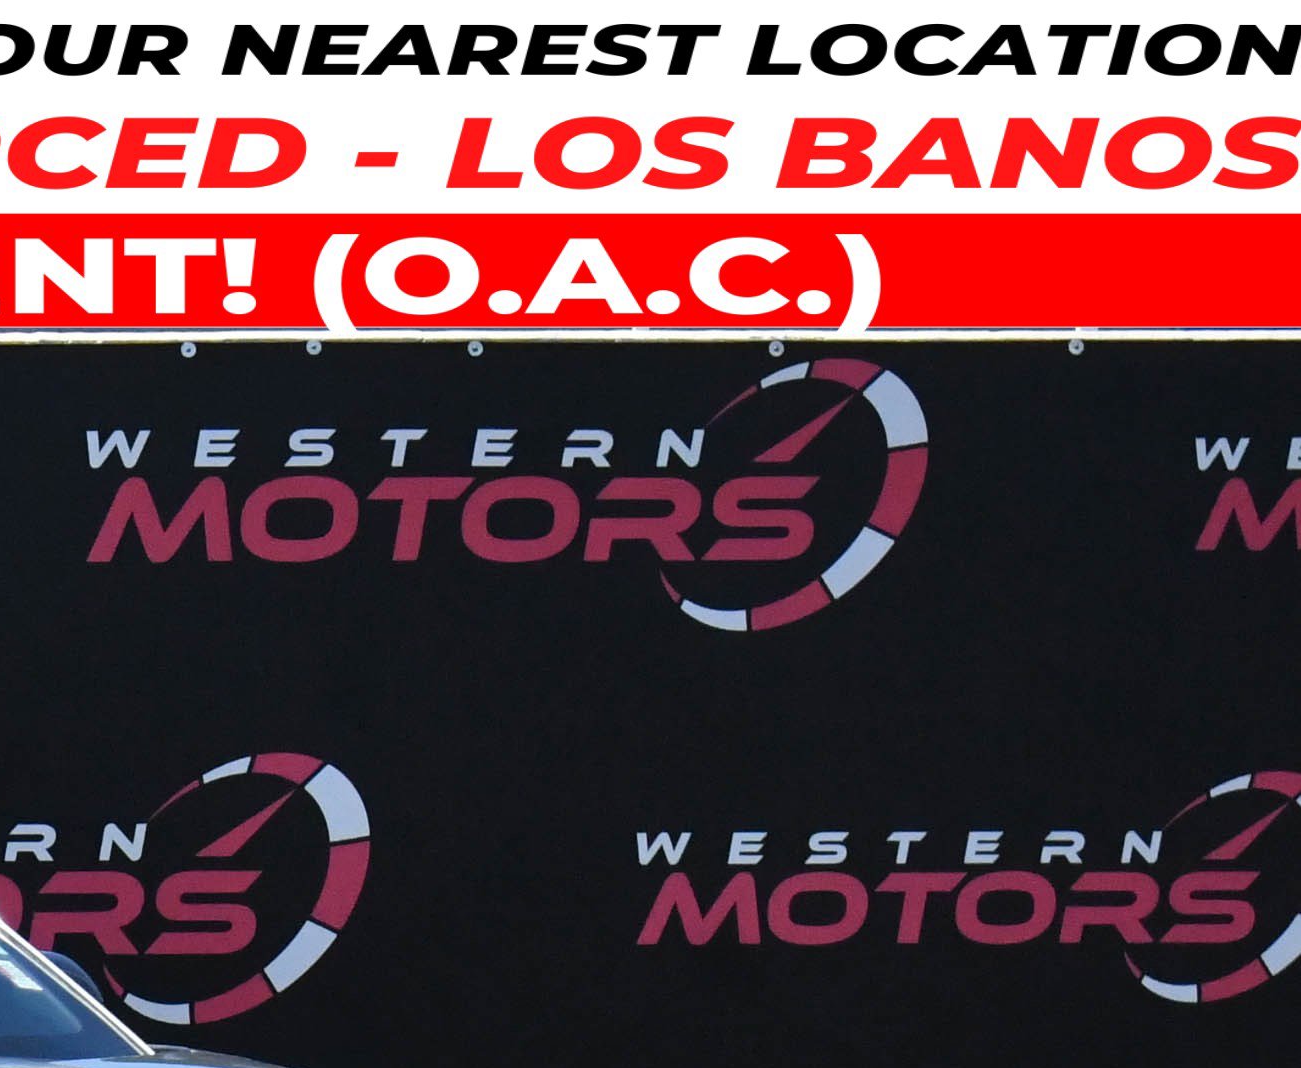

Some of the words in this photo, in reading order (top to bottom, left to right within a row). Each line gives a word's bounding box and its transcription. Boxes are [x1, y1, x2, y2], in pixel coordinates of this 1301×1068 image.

[86, 429, 705, 469] WESTERN
[87, 475, 819, 563] MOTORS
[636, 830, 1163, 866] WESTERN
[637, 870, 1260, 945] MOTORS
